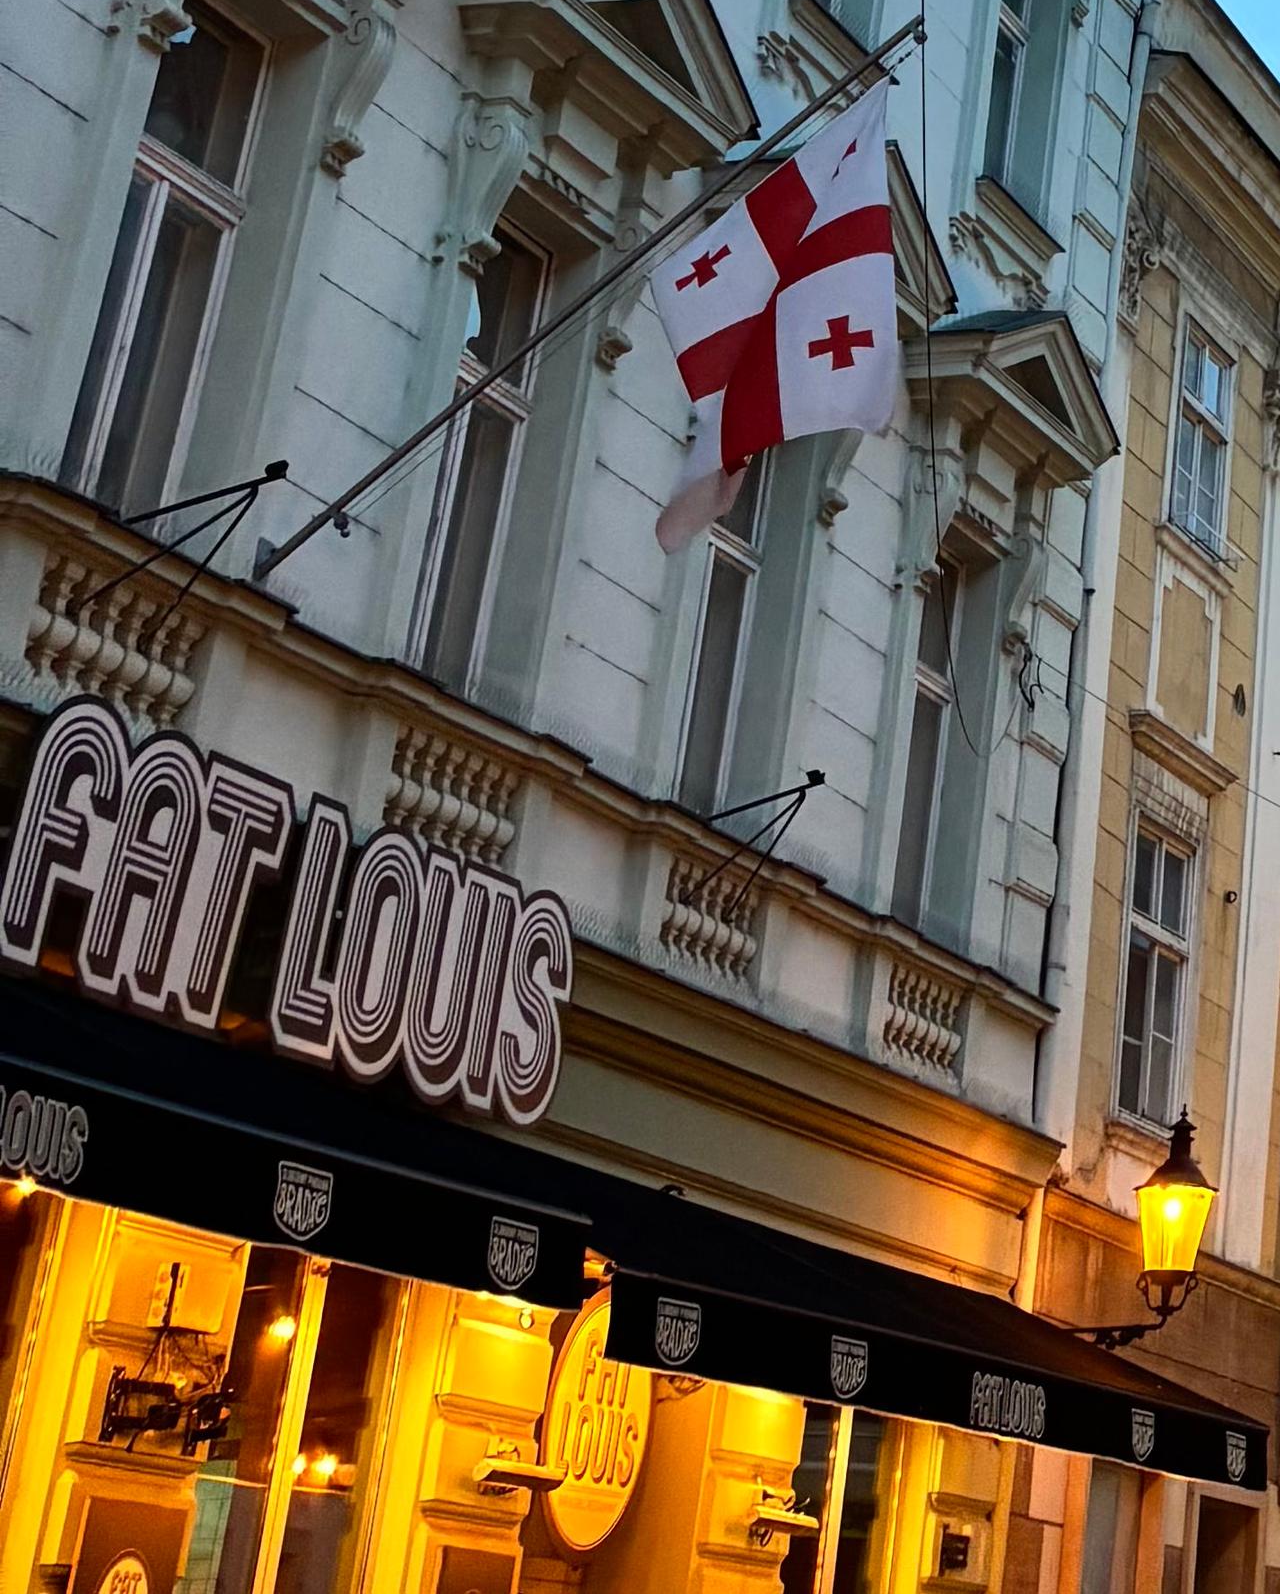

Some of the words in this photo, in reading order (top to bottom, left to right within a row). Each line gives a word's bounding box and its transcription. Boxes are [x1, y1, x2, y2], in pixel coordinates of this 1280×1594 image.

[2, 698, 294, 1030] FAT
[270, 793, 575, 1128] LOUIS
[0, 1084, 89, 1184] OUIS
[556, 1401, 639, 1488] LOUIS
[1000, 1377, 1046, 1439] LOUIS
